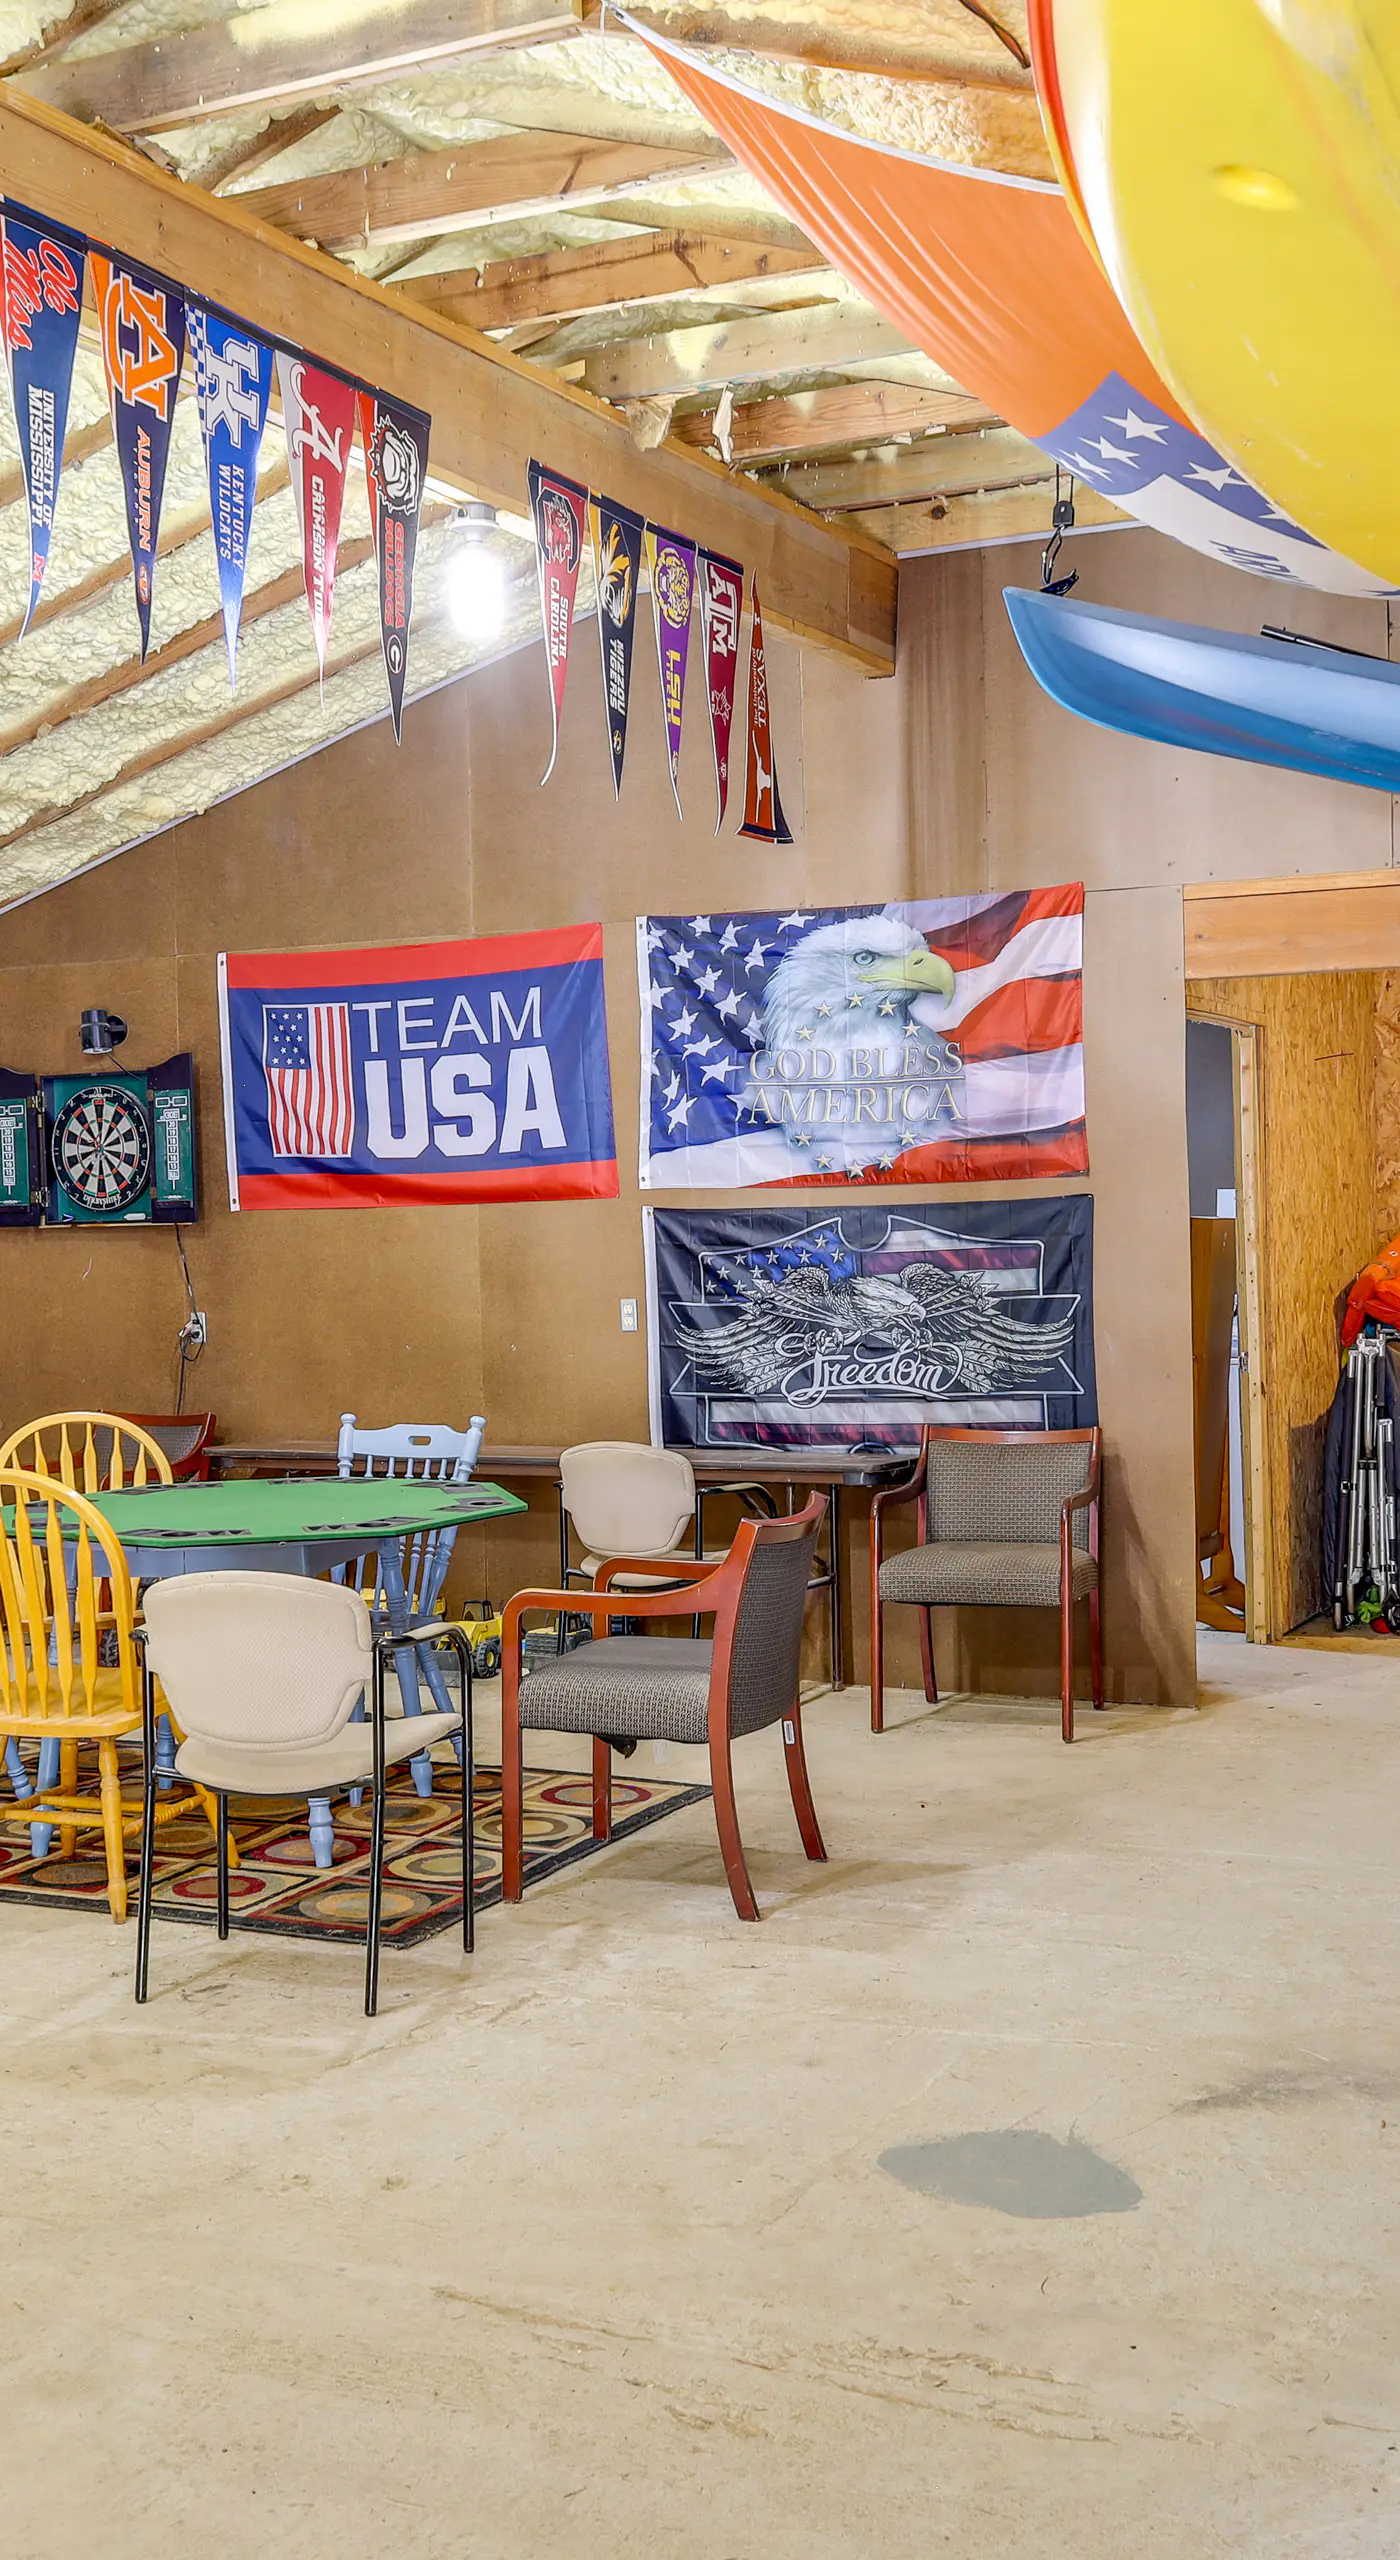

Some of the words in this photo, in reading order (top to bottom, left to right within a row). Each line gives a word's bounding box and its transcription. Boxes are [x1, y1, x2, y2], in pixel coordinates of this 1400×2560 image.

[3, 238, 43, 351] Miss
[39, 239, 79, 315] Ole
[28, 383, 44, 529] MISSISSIPPI
[43, 389, 55, 502] UNIVERSITY
[290, 363, 344, 474] A
[43, 503, 54, 531] OF
[137, 425, 151, 553] AUBURN
[218, 463, 233, 561] WILDCATS
[232, 463, 246, 571] KENTUCKY
[311, 474, 326, 572] CRIMSON
[33, 552, 45, 583] M
[385, 517, 395, 628] BULLDOGS
[394, 521, 406, 629] GEORGIA
[550, 577, 560, 667] CAROLINA
[559, 595, 569, 660] SOUTH
[609, 638, 618, 711] TIGERS
[616, 639, 626, 716] MIZZOU
[670, 649, 682, 727] LSU
[756, 648, 767, 729] TEXAS
[352, 985, 543, 1053] TEAM
[750, 1048, 837, 1081] GOD
[848, 1041, 964, 1080] BLESS
[364, 1044, 568, 1159] USA
[747, 1082, 968, 1125] AMERICA
[774, 1330, 964, 1408] Freedom
